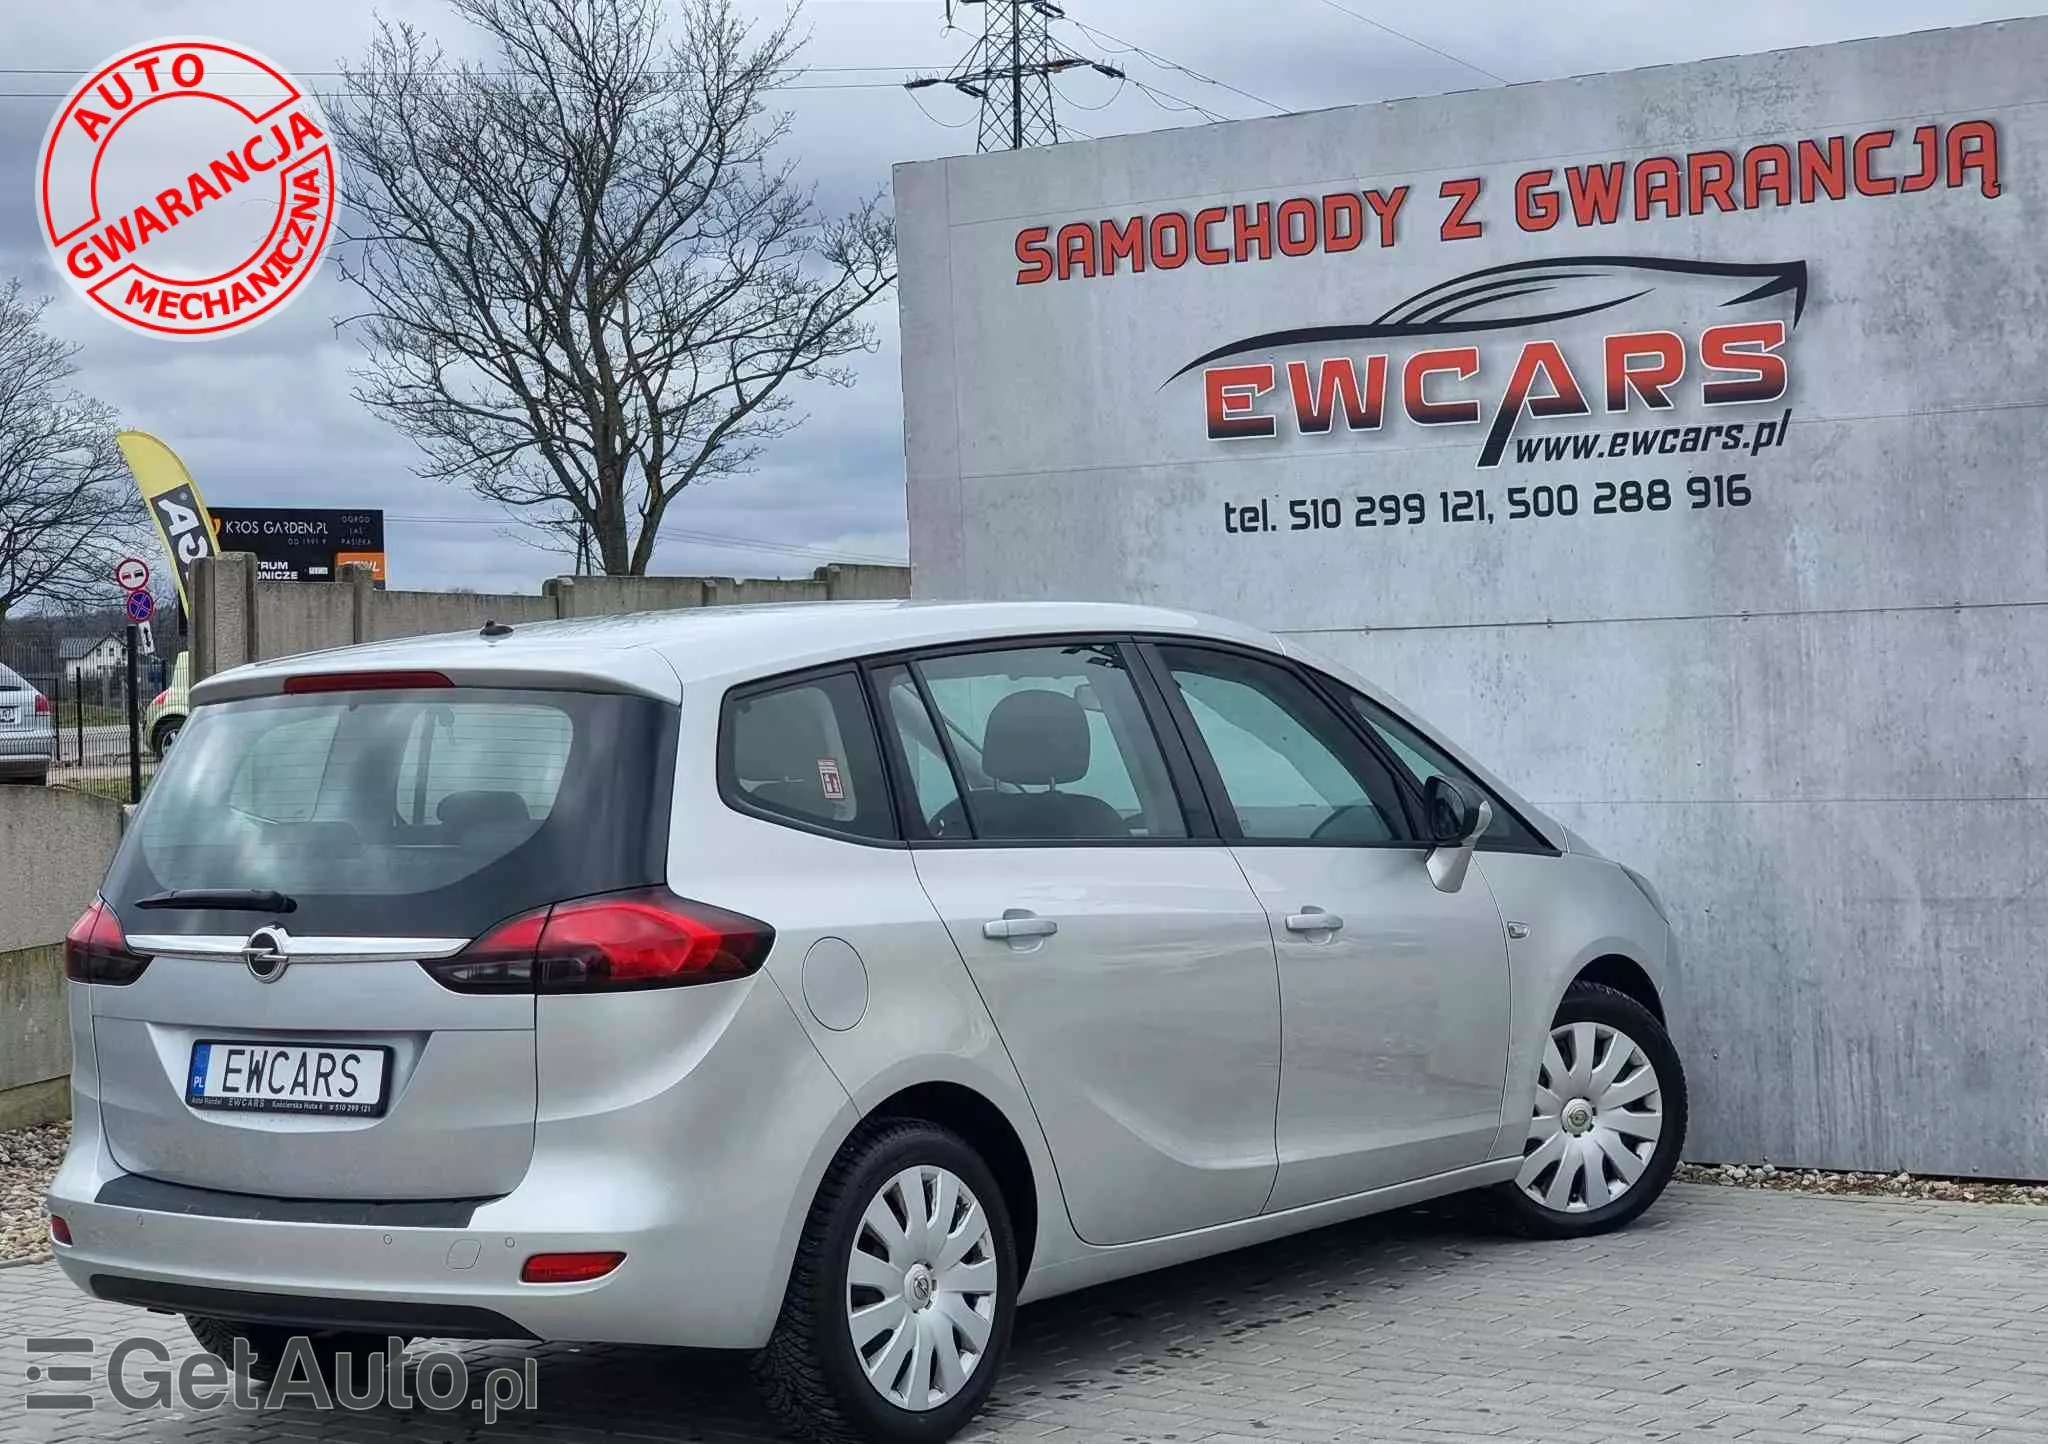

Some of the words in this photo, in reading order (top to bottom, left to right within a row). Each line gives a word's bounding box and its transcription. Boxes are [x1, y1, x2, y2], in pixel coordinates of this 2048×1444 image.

[1015, 186, 1409, 285] SAMOCHODY
[1439, 178, 1483, 241] Z
[1514, 119, 2000, 231] GWARANCJĄ
[1203, 320, 1788, 469] EWCARS
[1516, 408, 1792, 465] www.ewcars.pl
[226, 521, 259, 534] KROS
[264, 521, 328, 535] GARDEN.PL
[1224, 498, 1277, 533] tel.
[1289, 498, 1341, 531] 510
[1355, 492, 1425, 528] 299
[1440, 489, 1494, 524] 121,
[1508, 483, 1578, 520] 500
[1594, 478, 1672, 515] 288
[1686, 473, 1752, 509] 916
[222, 1049, 361, 1098] EWCARS
